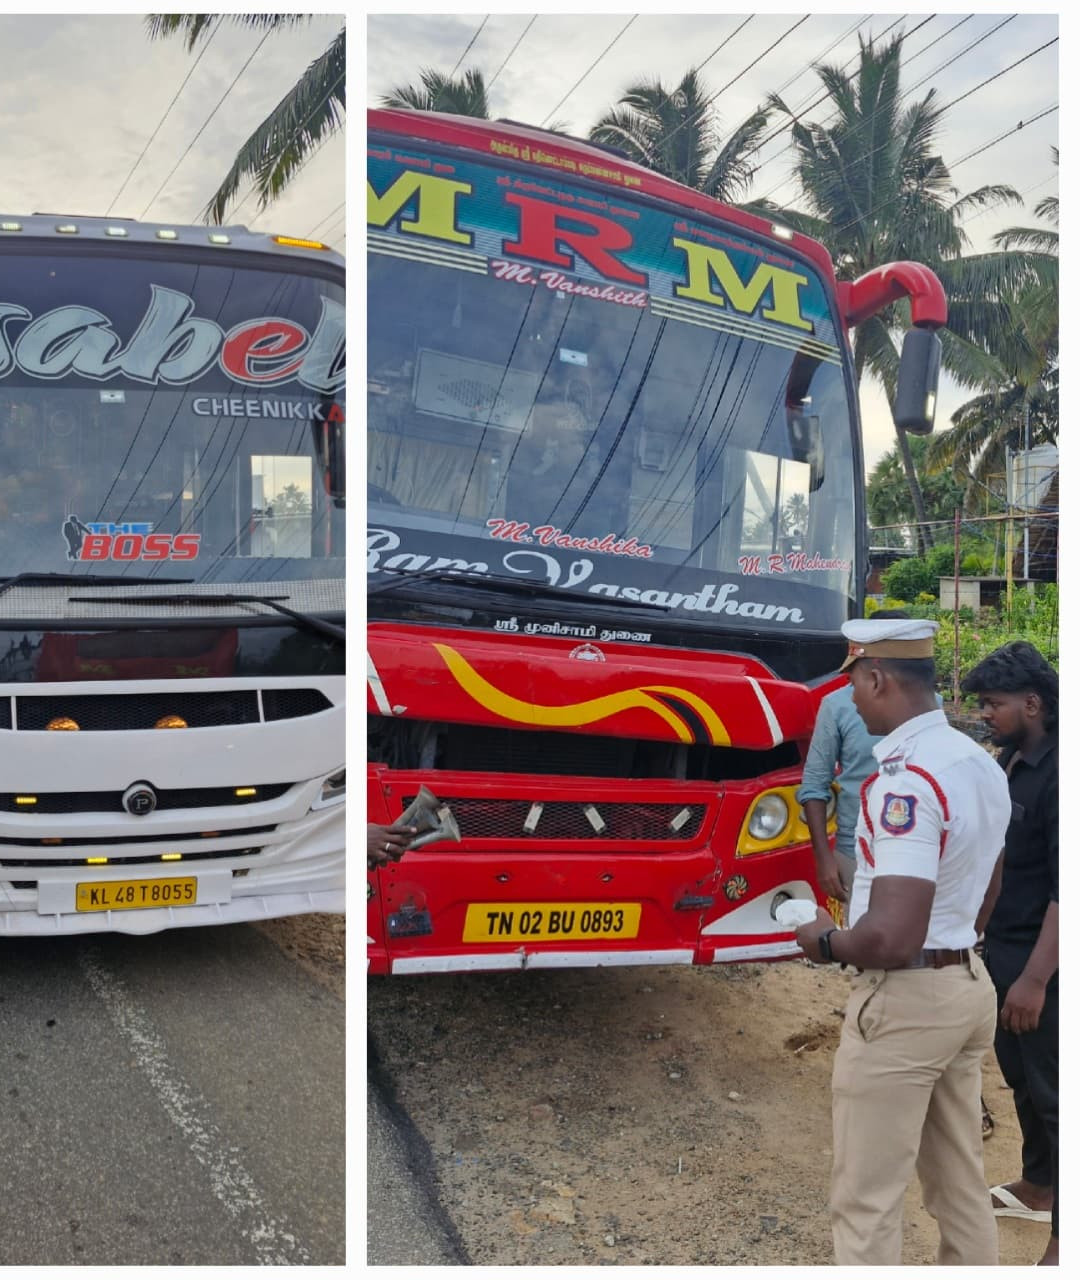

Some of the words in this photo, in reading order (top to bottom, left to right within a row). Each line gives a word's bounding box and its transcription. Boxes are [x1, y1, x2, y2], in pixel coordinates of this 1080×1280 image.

[87, 522, 153, 534] THE
[80, 534, 201, 561] BOSS
[493, 617, 519, 632] ஸ்ரீ
[523, 622, 596, 637] முனிசாமி
[599, 629, 652, 641] துணை
[90, 888, 110, 905] KL
[115, 886, 135, 904] 48
[487, 912, 514, 935] TN
[520, 911, 543, 934] 02
[547, 911, 575, 934] BU
[580, 910, 624, 933] 0893
